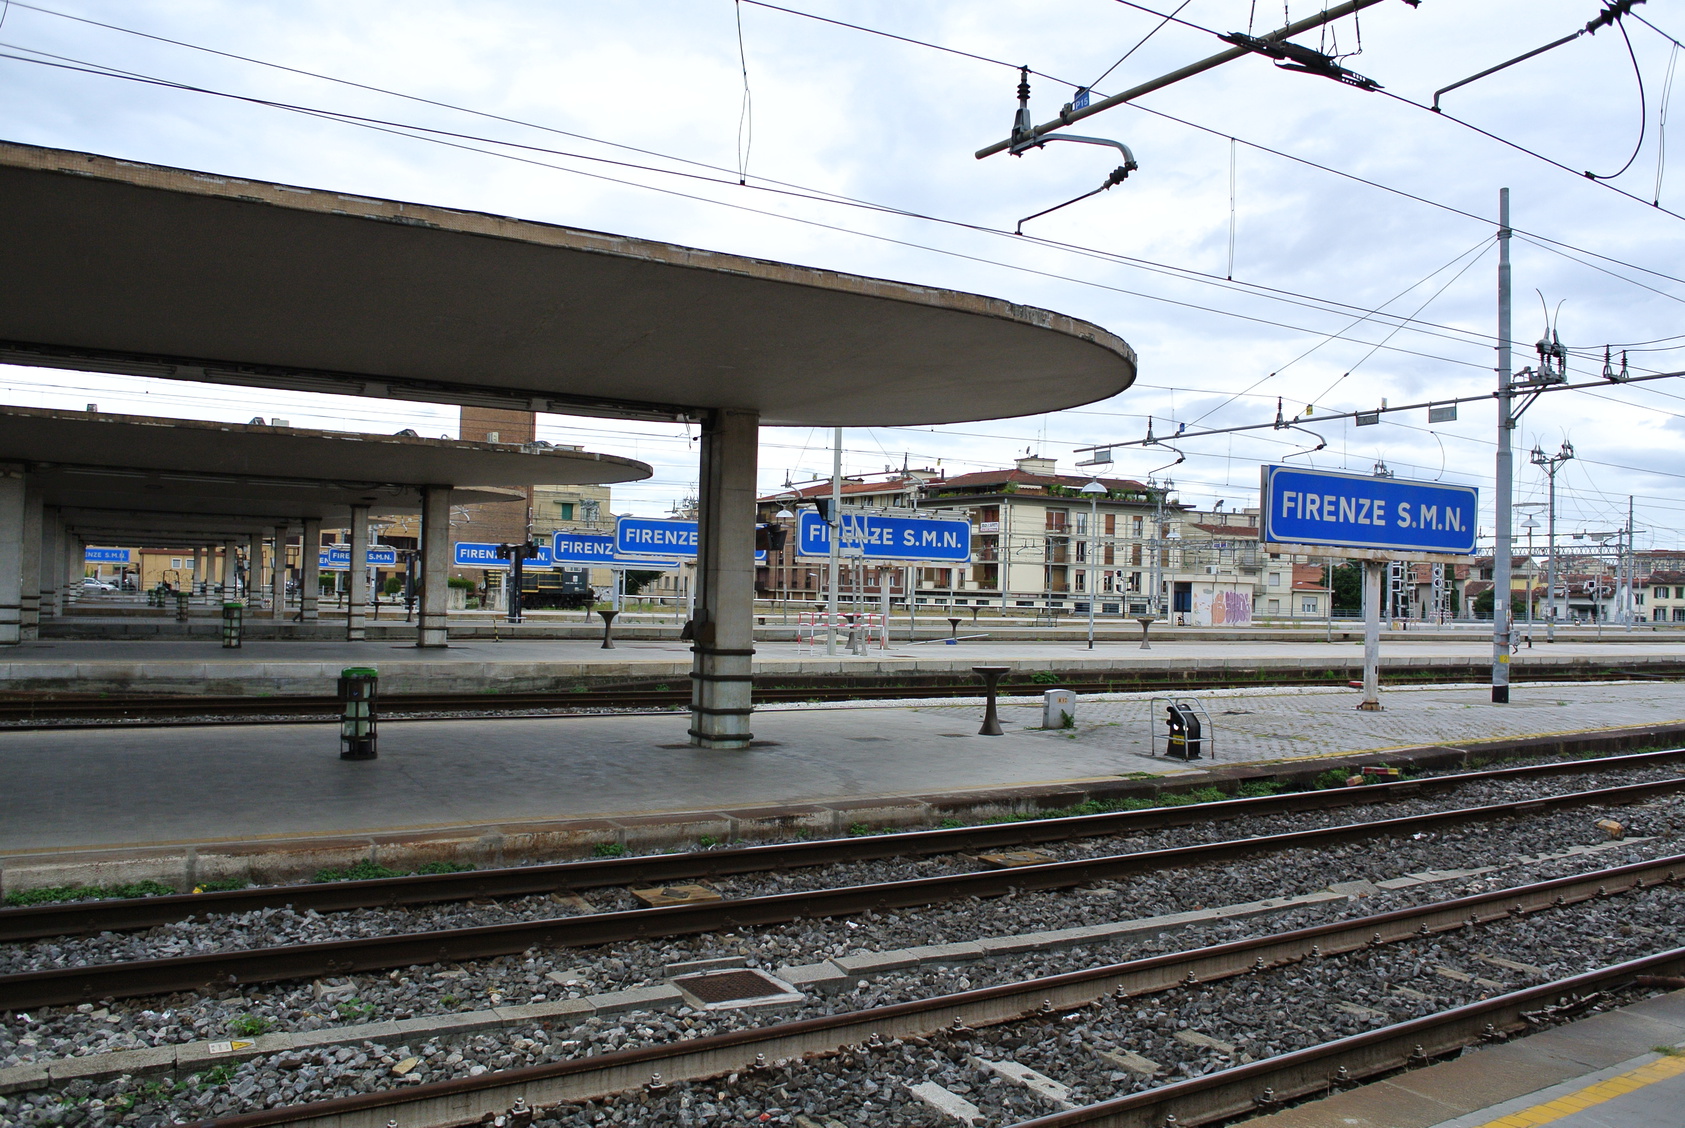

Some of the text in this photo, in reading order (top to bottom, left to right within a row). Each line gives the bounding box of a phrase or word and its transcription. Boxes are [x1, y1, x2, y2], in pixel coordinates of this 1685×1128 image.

[1075, 97, 1089, 110] P15
[1282, 490, 1467, 532] FIRENZE S.M.N.
[625, 528, 698, 546] FIRENZE
[809, 524, 962, 548] FIENZE S.M.N.
[560, 541, 613, 555] FIRENZ
[368, 553, 392, 561] S.M.N.
